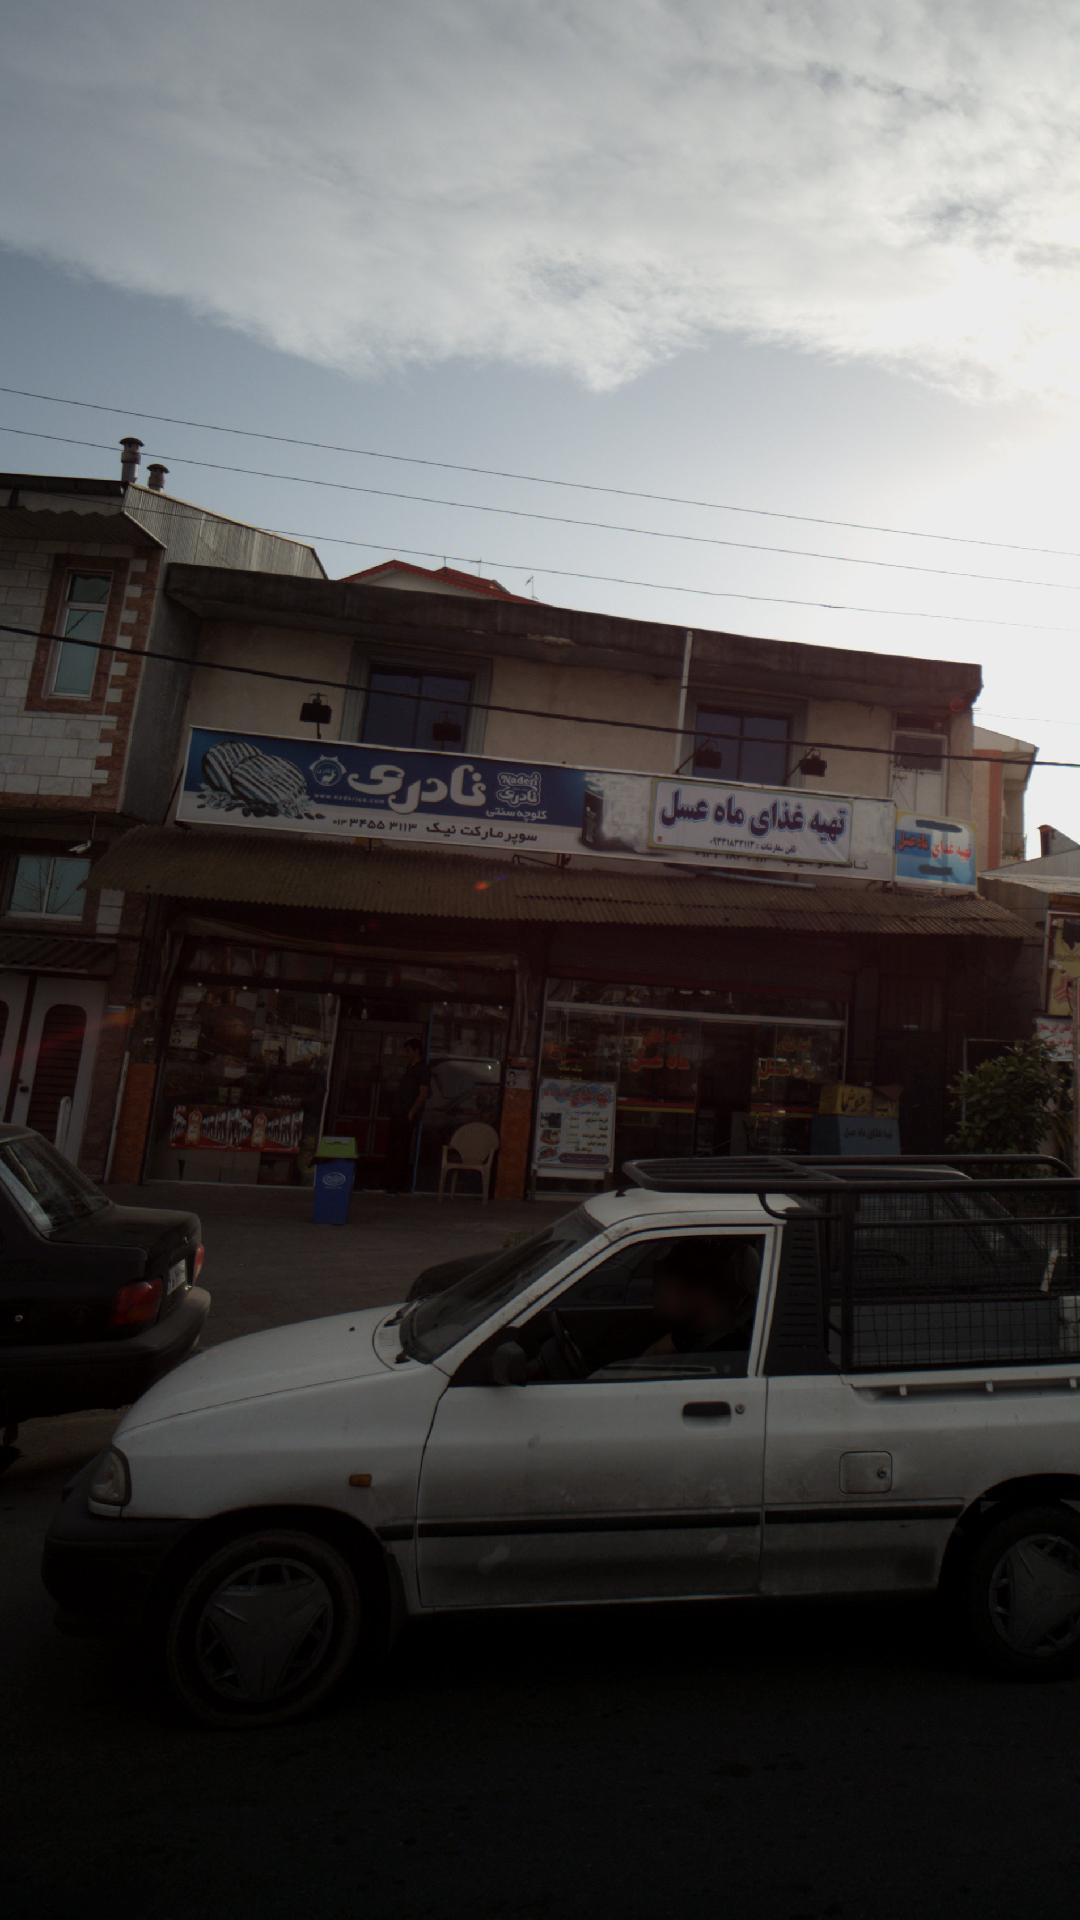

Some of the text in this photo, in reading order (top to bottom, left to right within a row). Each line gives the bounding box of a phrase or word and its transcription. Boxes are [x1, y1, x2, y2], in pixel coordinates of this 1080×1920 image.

[499, 773, 539, 786] Naderi
[347, 763, 487, 815] نادری
[497, 787, 540, 805] نادری
[485, 807, 548, 822] کلوچه سنتی
[661, 790, 846, 842] تهیه غذای ماه عسل
[426, 822, 457, 837] نیک
